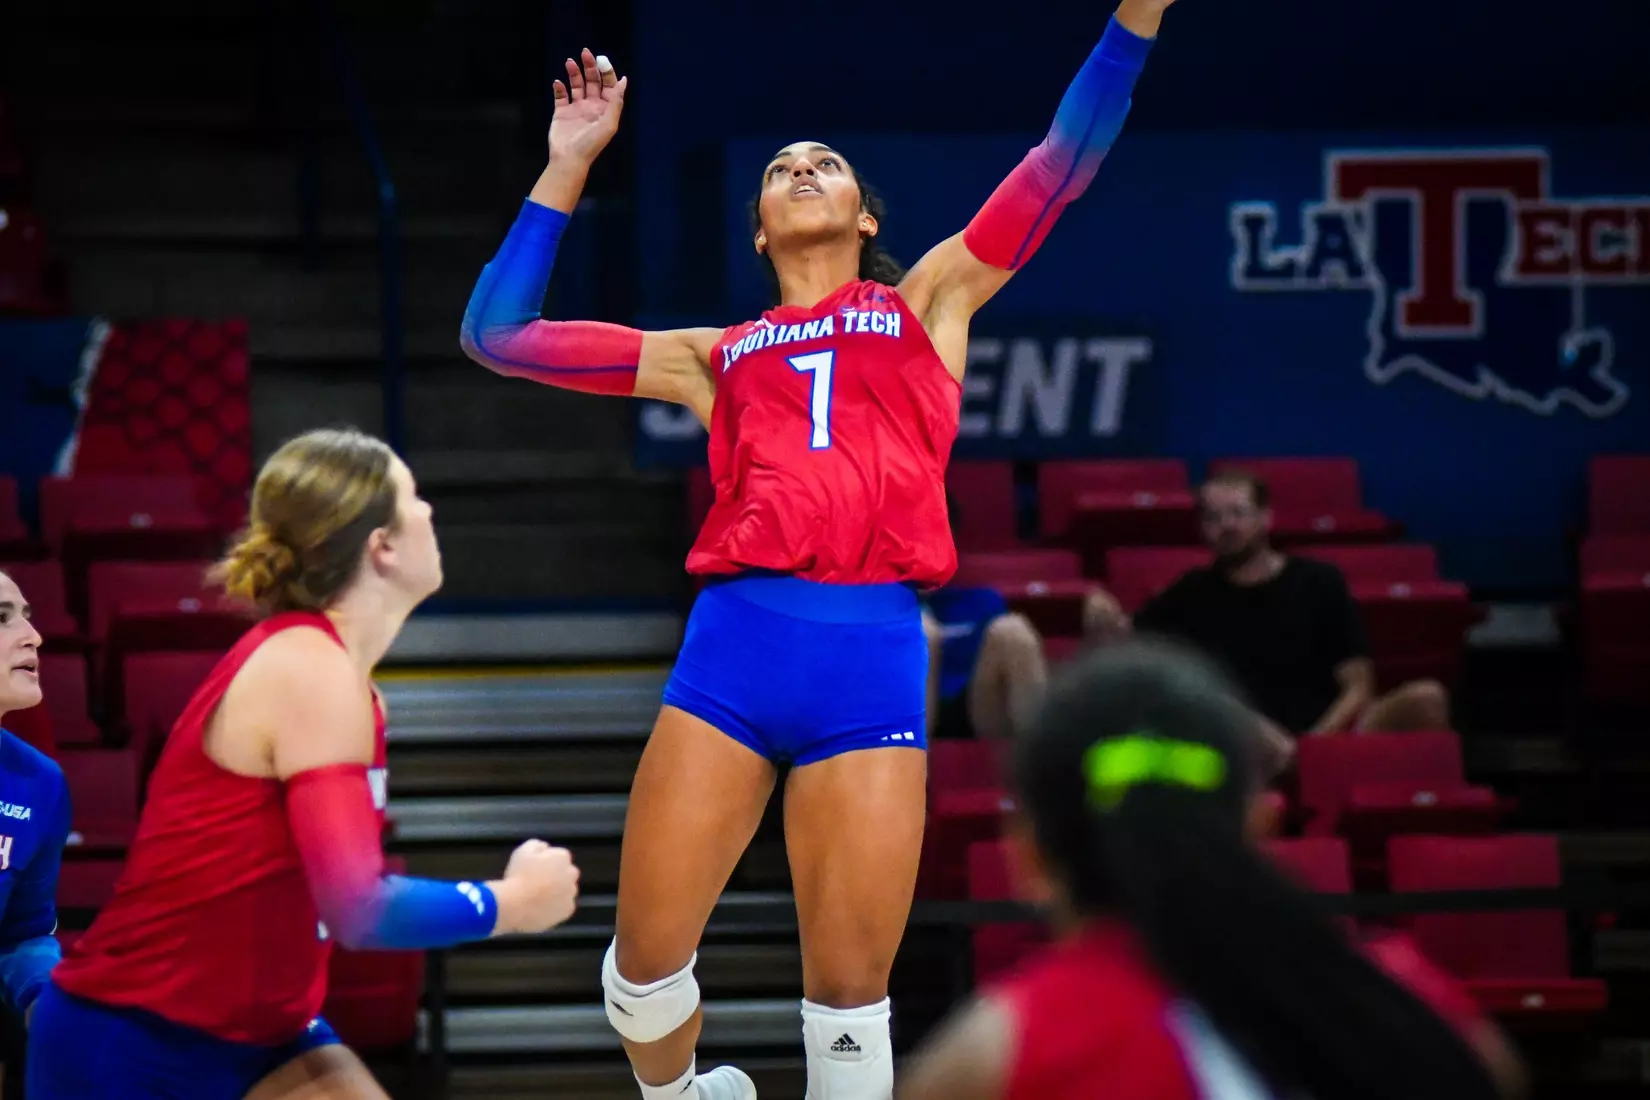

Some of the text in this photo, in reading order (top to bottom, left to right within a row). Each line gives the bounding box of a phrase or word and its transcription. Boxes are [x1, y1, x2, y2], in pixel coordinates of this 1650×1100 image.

[1229, 201, 1374, 291] LA
[722, 311, 901, 373] LOUISIANA TECH
[785, 349, 836, 451] 7
[0, 800, 31, 821] USA
